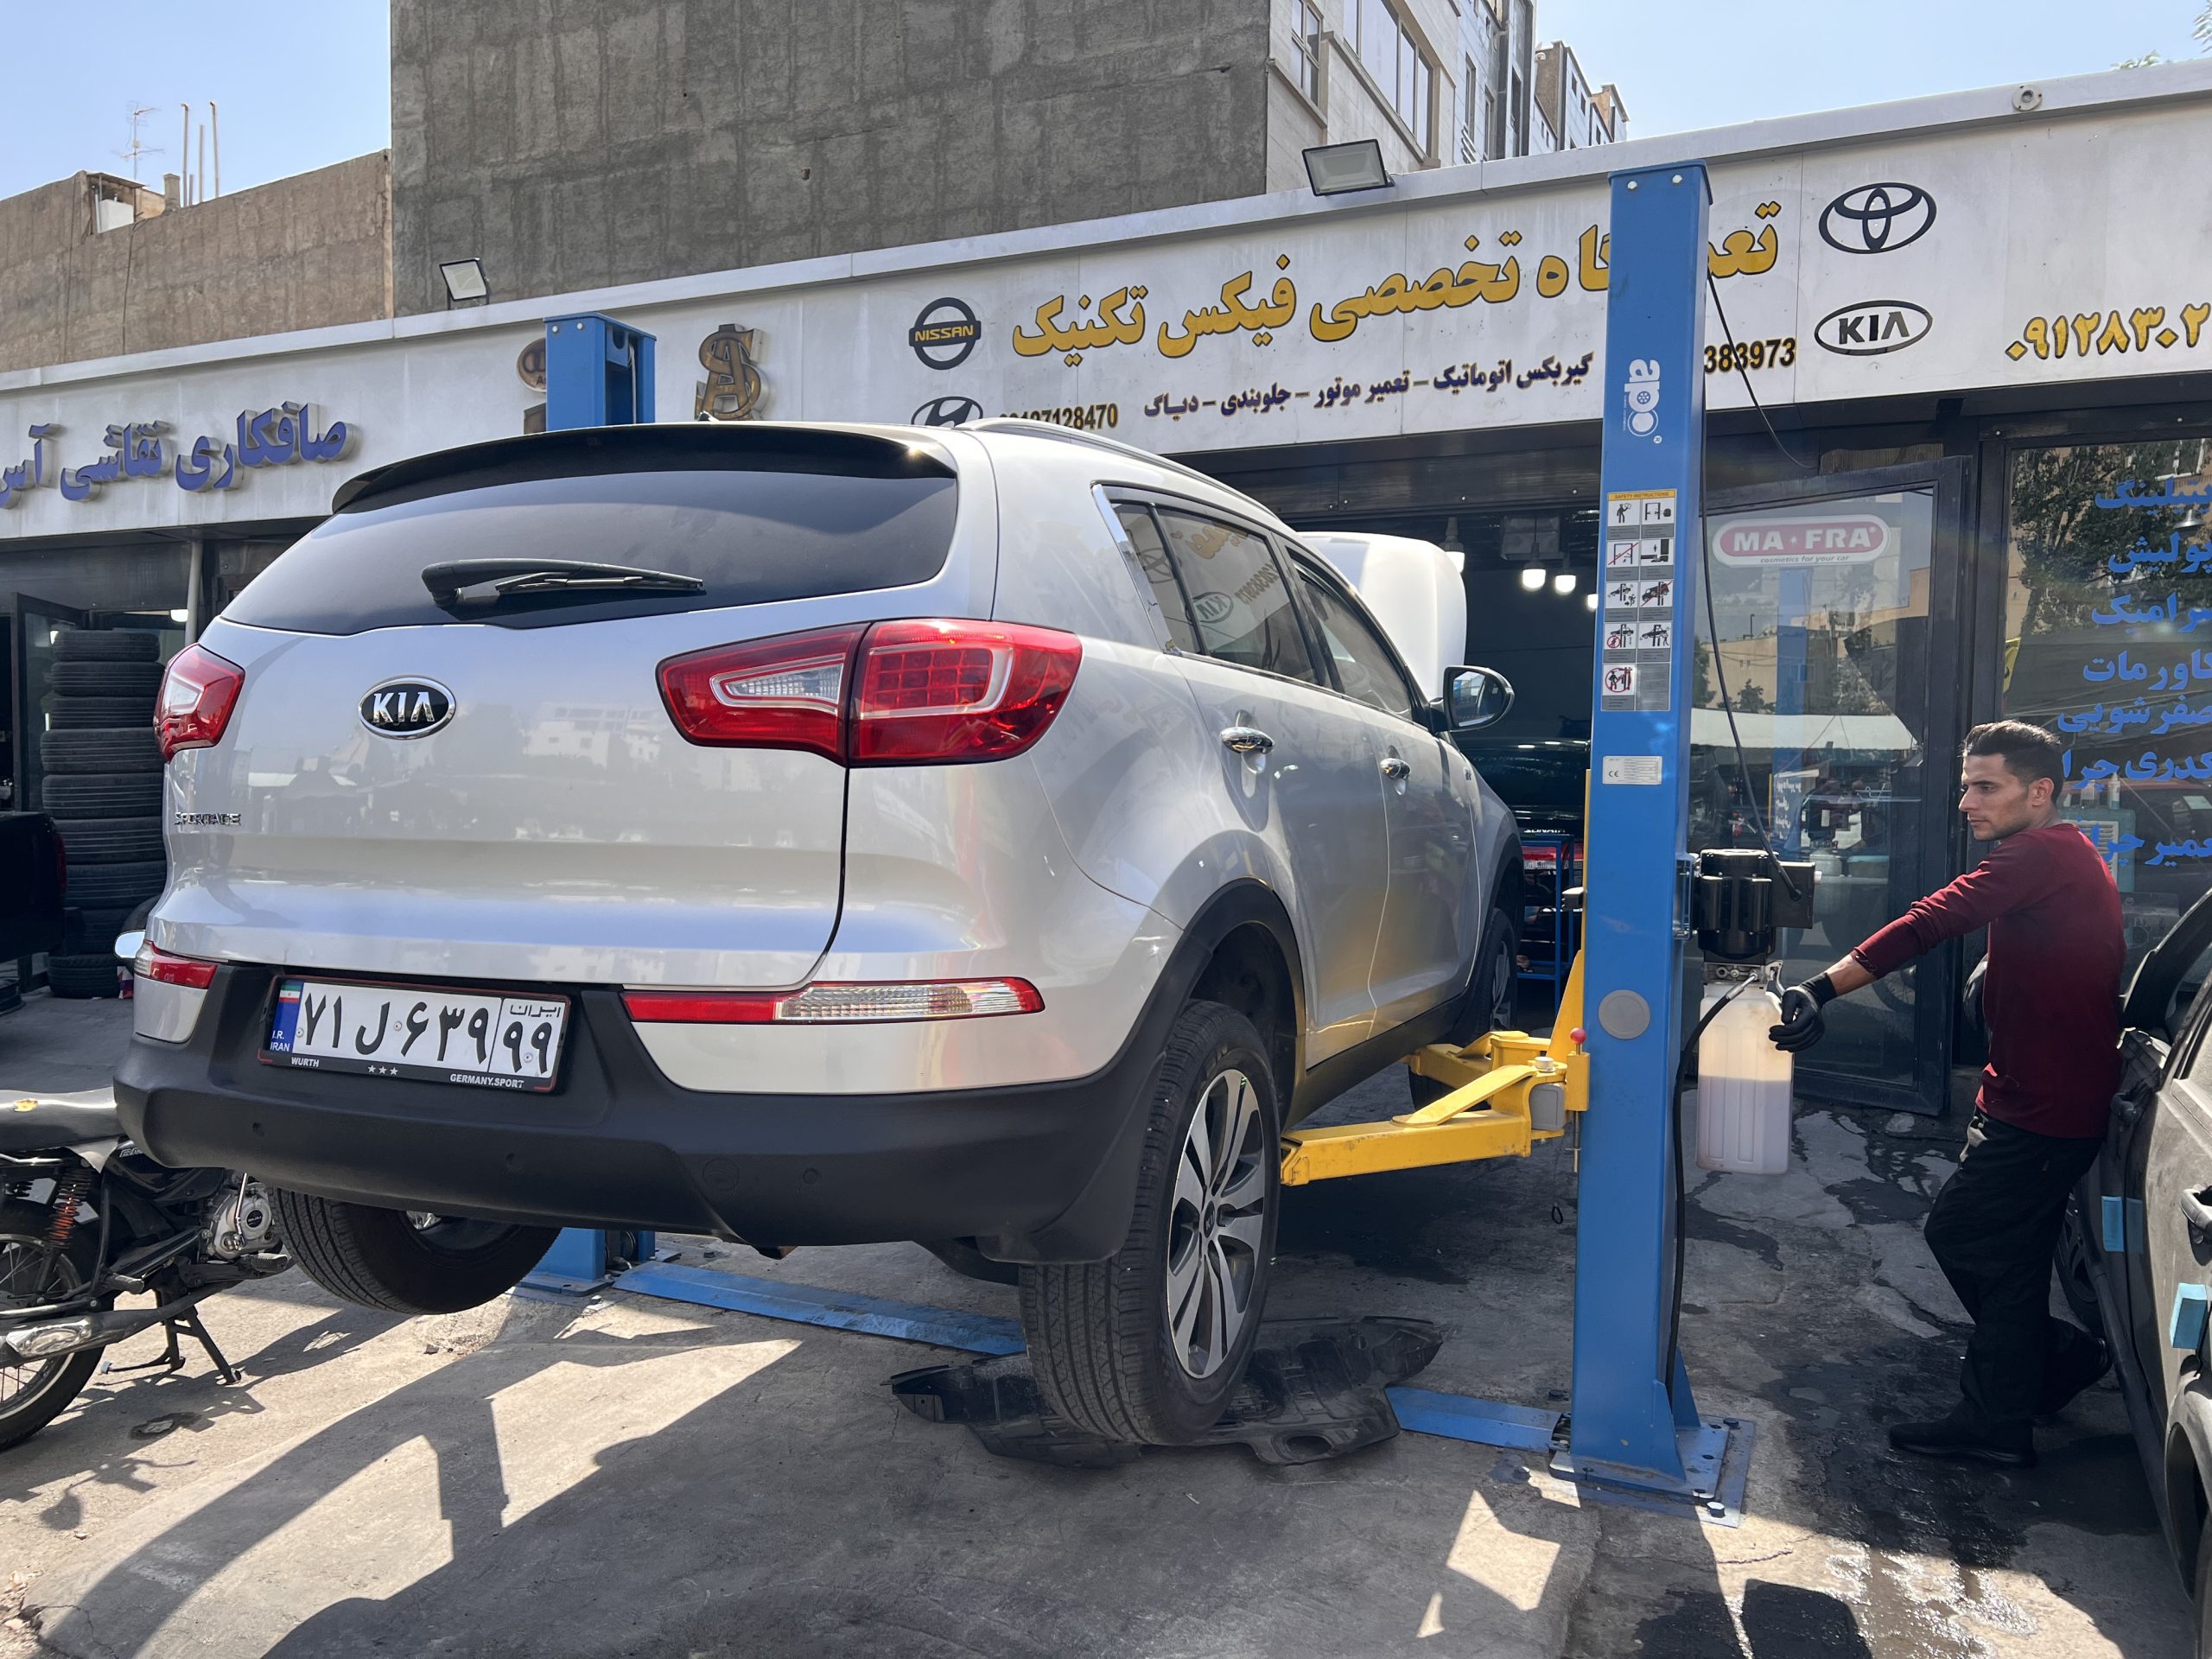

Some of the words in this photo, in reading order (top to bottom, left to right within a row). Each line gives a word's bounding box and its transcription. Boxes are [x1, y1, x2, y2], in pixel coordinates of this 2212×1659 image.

[1309, 230, 1522, 341] تخصصی
[1157, 253, 1296, 358] فیکس
[915, 324, 974, 342] NISSAN
[1013, 285, 1148, 366] تکنیک
[1839, 311, 1910, 344] KIA
[1703, 337, 1796, 373] 383973
[1221, 382, 1292, 416] جلوبندی
[1314, 377, 1361, 408] موتور
[1364, 369, 1411, 404] تعمیر
[60, 421, 167, 501] نقاشی
[175, 401, 348, 492] صافکاری
[1815, 556, 1834, 564] your
[372, 691, 435, 723] KIA
[510, 1004, 561, 1018] ایران
[270, 1042, 290, 1052] IRAN
[271, 1030, 284, 1039] I.R.
[503, 1021, 552, 1075] ۹۹
[291, 1057, 320, 1068] WURTH
[449, 1073, 524, 1089] GERMANY.SPORT
